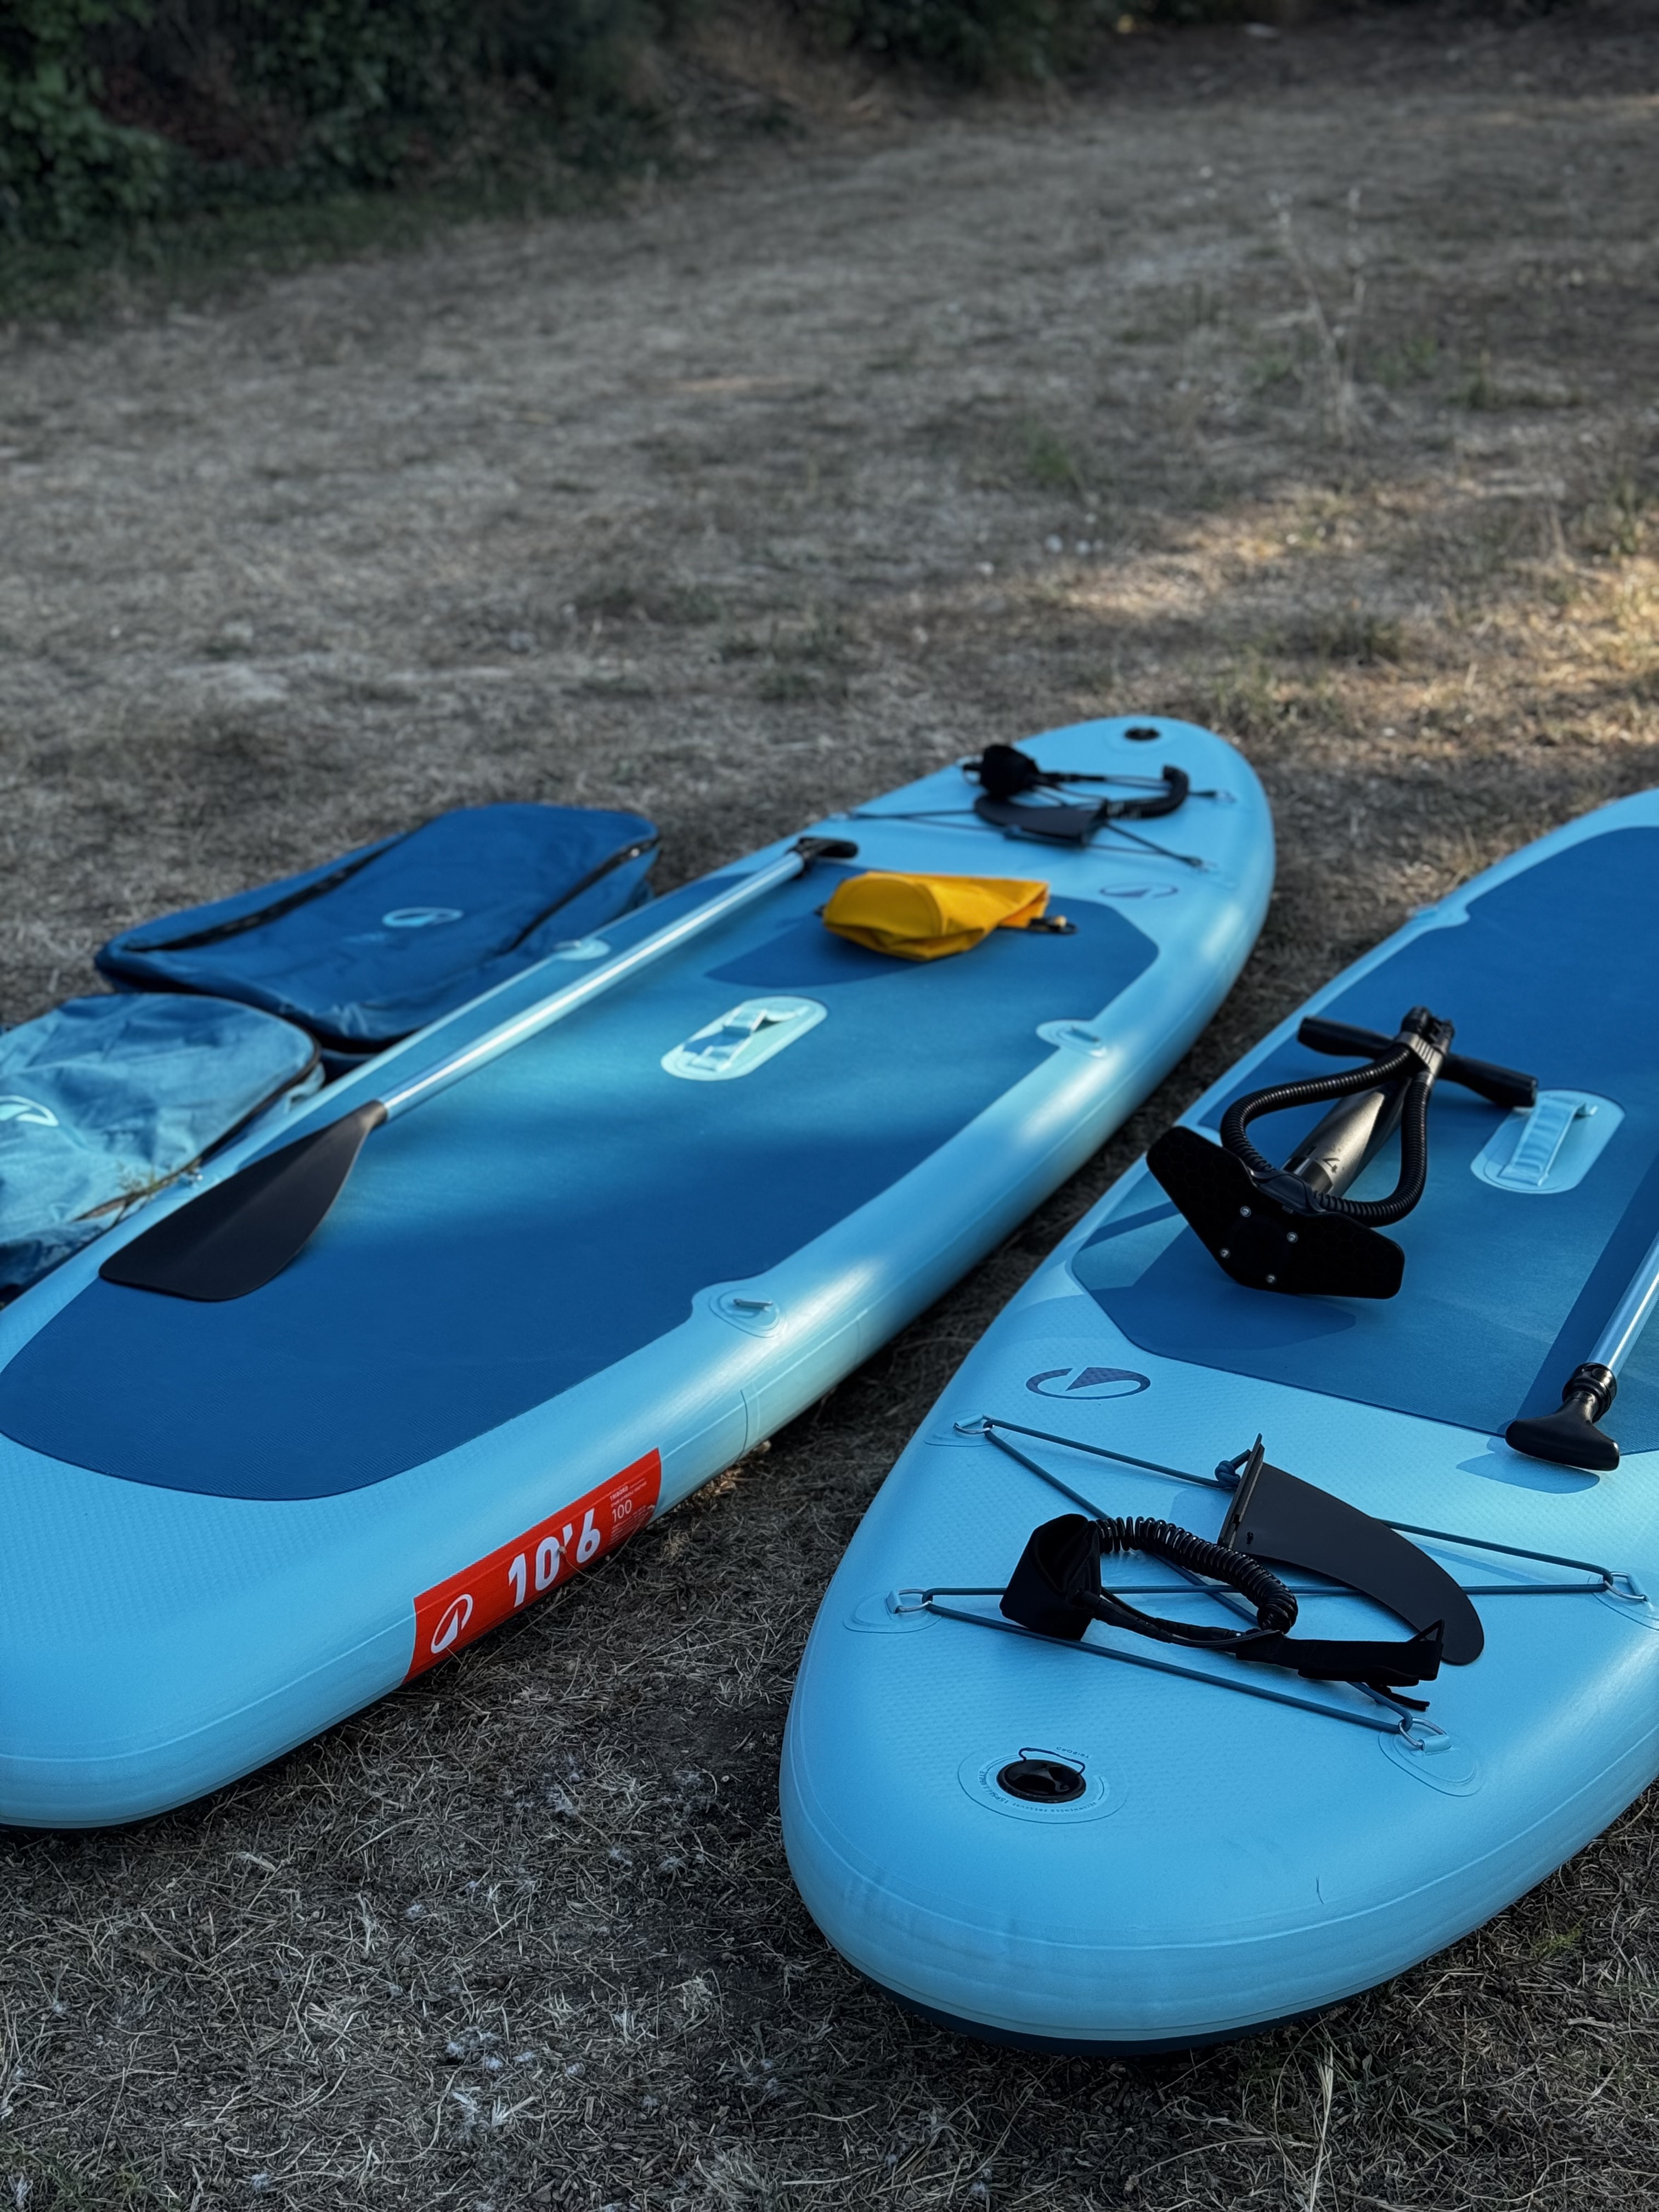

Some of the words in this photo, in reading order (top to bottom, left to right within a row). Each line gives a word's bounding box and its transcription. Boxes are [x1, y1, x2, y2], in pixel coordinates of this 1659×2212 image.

[612, 1499, 632, 1522] 100
[1056, 1746, 1090, 1759] TRIBORD
[1012, 1803, 1048, 1812] PRESSURE
[1050, 1802, 1097, 1813] RECOMMENDED
